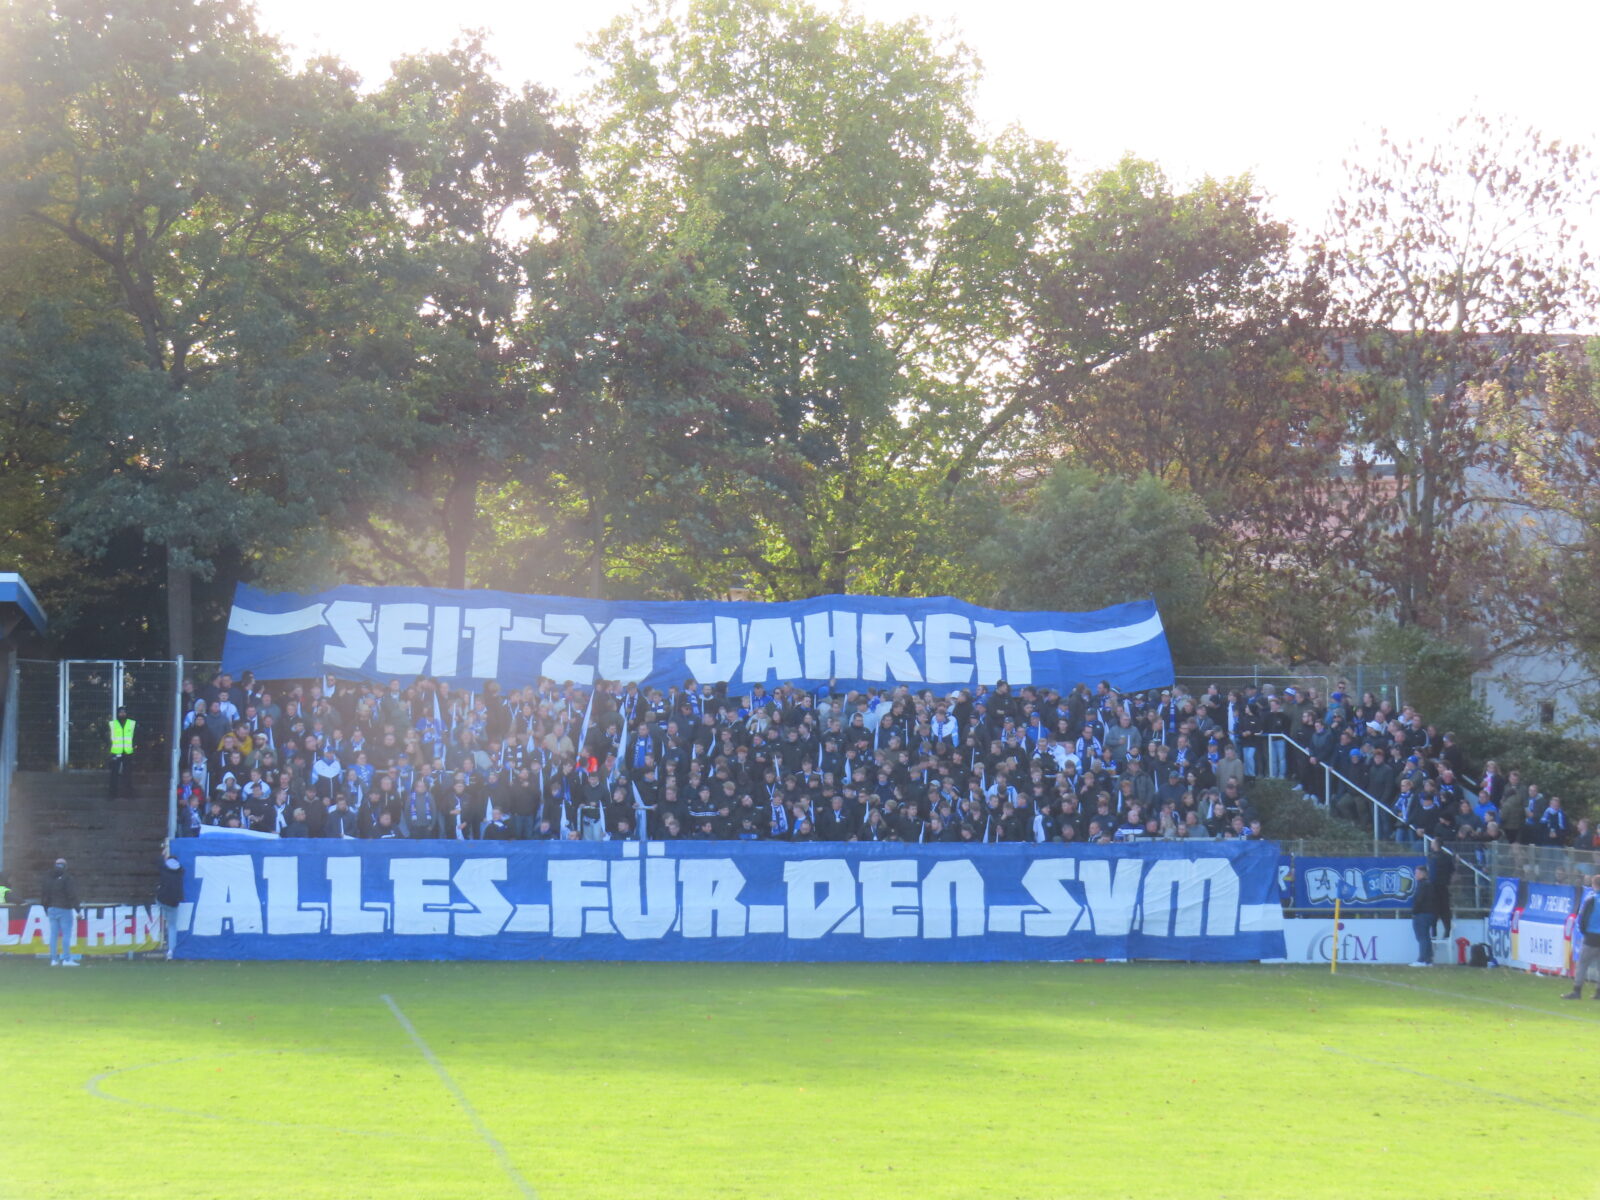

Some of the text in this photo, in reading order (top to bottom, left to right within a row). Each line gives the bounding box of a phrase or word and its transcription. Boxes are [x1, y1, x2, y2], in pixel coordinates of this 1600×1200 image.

[322, 600, 511, 679] SEIT
[685, 609, 1032, 685] JAHREN
[192, 854, 515, 937] ALLES
[547, 841, 747, 940] FÜR
[783, 858, 985, 939] DEN
[1021, 857, 1240, 937] SVM
